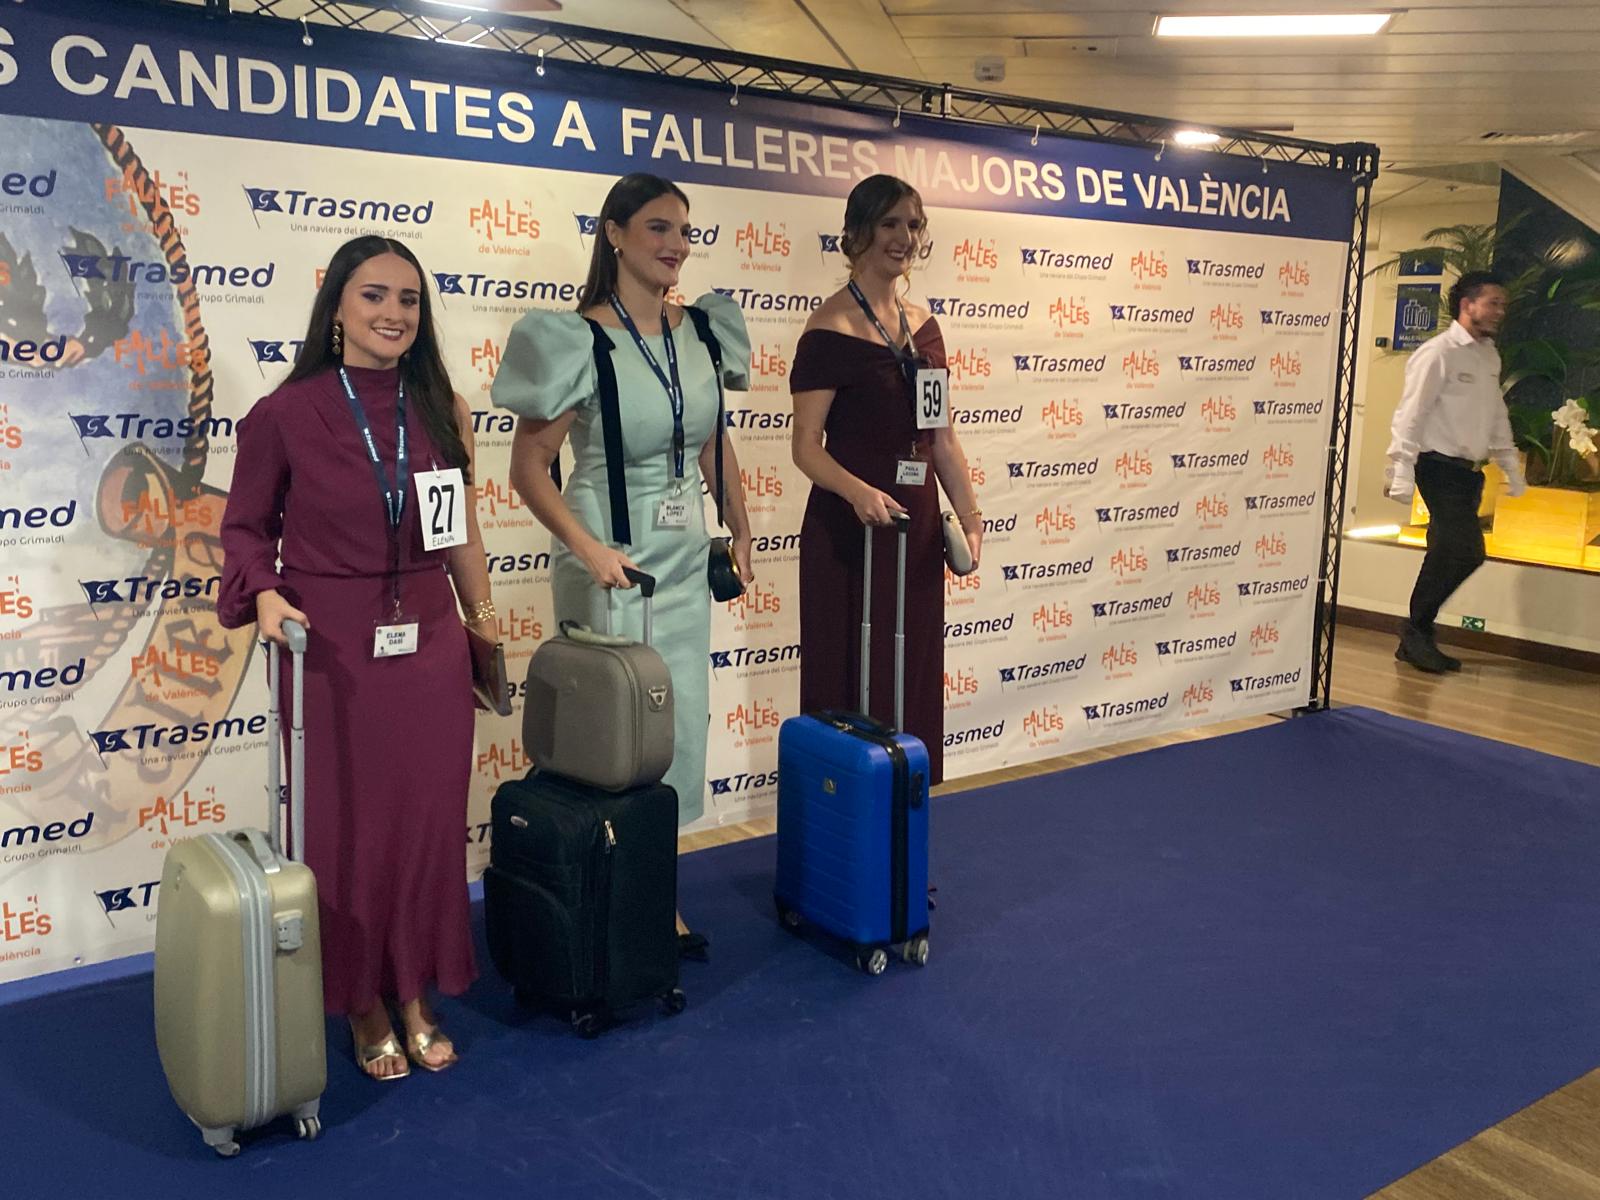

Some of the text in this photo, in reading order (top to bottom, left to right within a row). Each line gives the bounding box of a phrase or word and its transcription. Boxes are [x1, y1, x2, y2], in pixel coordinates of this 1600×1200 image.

[50, 35, 536, 144] CANDIDATES
[552, 100, 597, 152] A
[622, 107, 881, 182] FALLERES
[893, 144, 1066, 202] MAJORS
[1076, 166, 1128, 206] DE
[1133, 173, 1291, 222] VALÈNCIA
[284, 190, 434, 225] Trasmed
[290, 224, 308, 232] Una
[310, 226, 342, 234] naviera
[344, 226, 358, 235] del
[387, 230, 423, 240] Grimaldi
[469, 199, 541, 242] FALLES
[478, 244, 531, 257] de València
[735, 221, 791, 259] FALLES
[740, 262, 782, 272] de València
[954, 238, 998, 272] FALLES
[1039, 249, 1113, 271] Trasmed
[1131, 250, 1168, 281] FALLES
[109, 256, 275, 289] Trasmed
[1200, 260, 1265, 280] Trasmed
[224, 294, 264, 304] Grimaldi
[738, 288, 823, 312] Trasme
[947, 298, 1030, 319] Trasmed
[1049, 296, 1090, 328] FALLES
[1126, 306, 1195, 323] Trasmed
[1273, 311, 1331, 328] Trasmed
[751, 343, 787, 377] LLES
[1031, 355, 1106, 373] Trasmed
[1122, 350, 1160, 379] FALLES
[1193, 356, 1257, 373] Trasmed
[8, 370, 55, 380] Grimaldi
[923, 379, 942, 419] 59
[1119, 401, 1187, 421] Trasmed
[1265, 399, 1324, 416] Trasmed
[951, 406, 1024, 425] rasmed
[1042, 398, 1084, 430] FALLES
[115, 413, 233, 440] Trasm
[491, 440, 511, 448] navie
[1024, 458, 1100, 479] Trasmed
[1115, 448, 1153, 479] FALLES
[1186, 450, 1250, 469] Trasmed
[740, 467, 783, 502] ALLES
[475, 479, 526, 516] FALL
[1257, 490, 1316, 510] Trasmed
[428, 484, 455, 536] 27
[1035, 504, 1077, 535] FALLES
[1112, 501, 1181, 523] Trasmed
[483, 518, 533, 529] de València
[19, 535, 65, 546] Grimaldi
[431, 534, 455, 547] ELENA
[1180, 541, 1242, 563] Trasmed
[485, 552, 551, 573] rasm
[1020, 556, 1095, 580] Trasmed
[1110, 546, 1149, 579] FALLES
[1252, 575, 1310, 596] Trasmed
[1107, 591, 1173, 618] Trasmed
[498, 607, 543, 641] LLES
[1032, 601, 1074, 634] FALLES
[734, 644, 801, 667] Trasm
[1101, 640, 1139, 671] FALLES
[1171, 631, 1237, 656] Trasmed
[131, 644, 219, 687] FALLES
[1016, 654, 1088, 683] Trasmed
[1245, 667, 1302, 692] Trasmed
[30, 692, 75, 705] Grimaldi
[1100, 693, 1170, 719] Trasmed
[726, 700, 780, 737] FALLES
[1023, 704, 1065, 738] FALLES
[133, 713, 267, 749] Trasme
[140, 756, 159, 766] Una
[161, 751, 196, 763] naviera
[214, 744, 242, 757] Grupo
[243, 740, 269, 752] Grima
[734, 770, 778, 792] Tras
[139, 790, 226, 836] FALLES
[4, 844, 82, 864] Grupo Grimaldi
[151, 839, 166, 850] de
